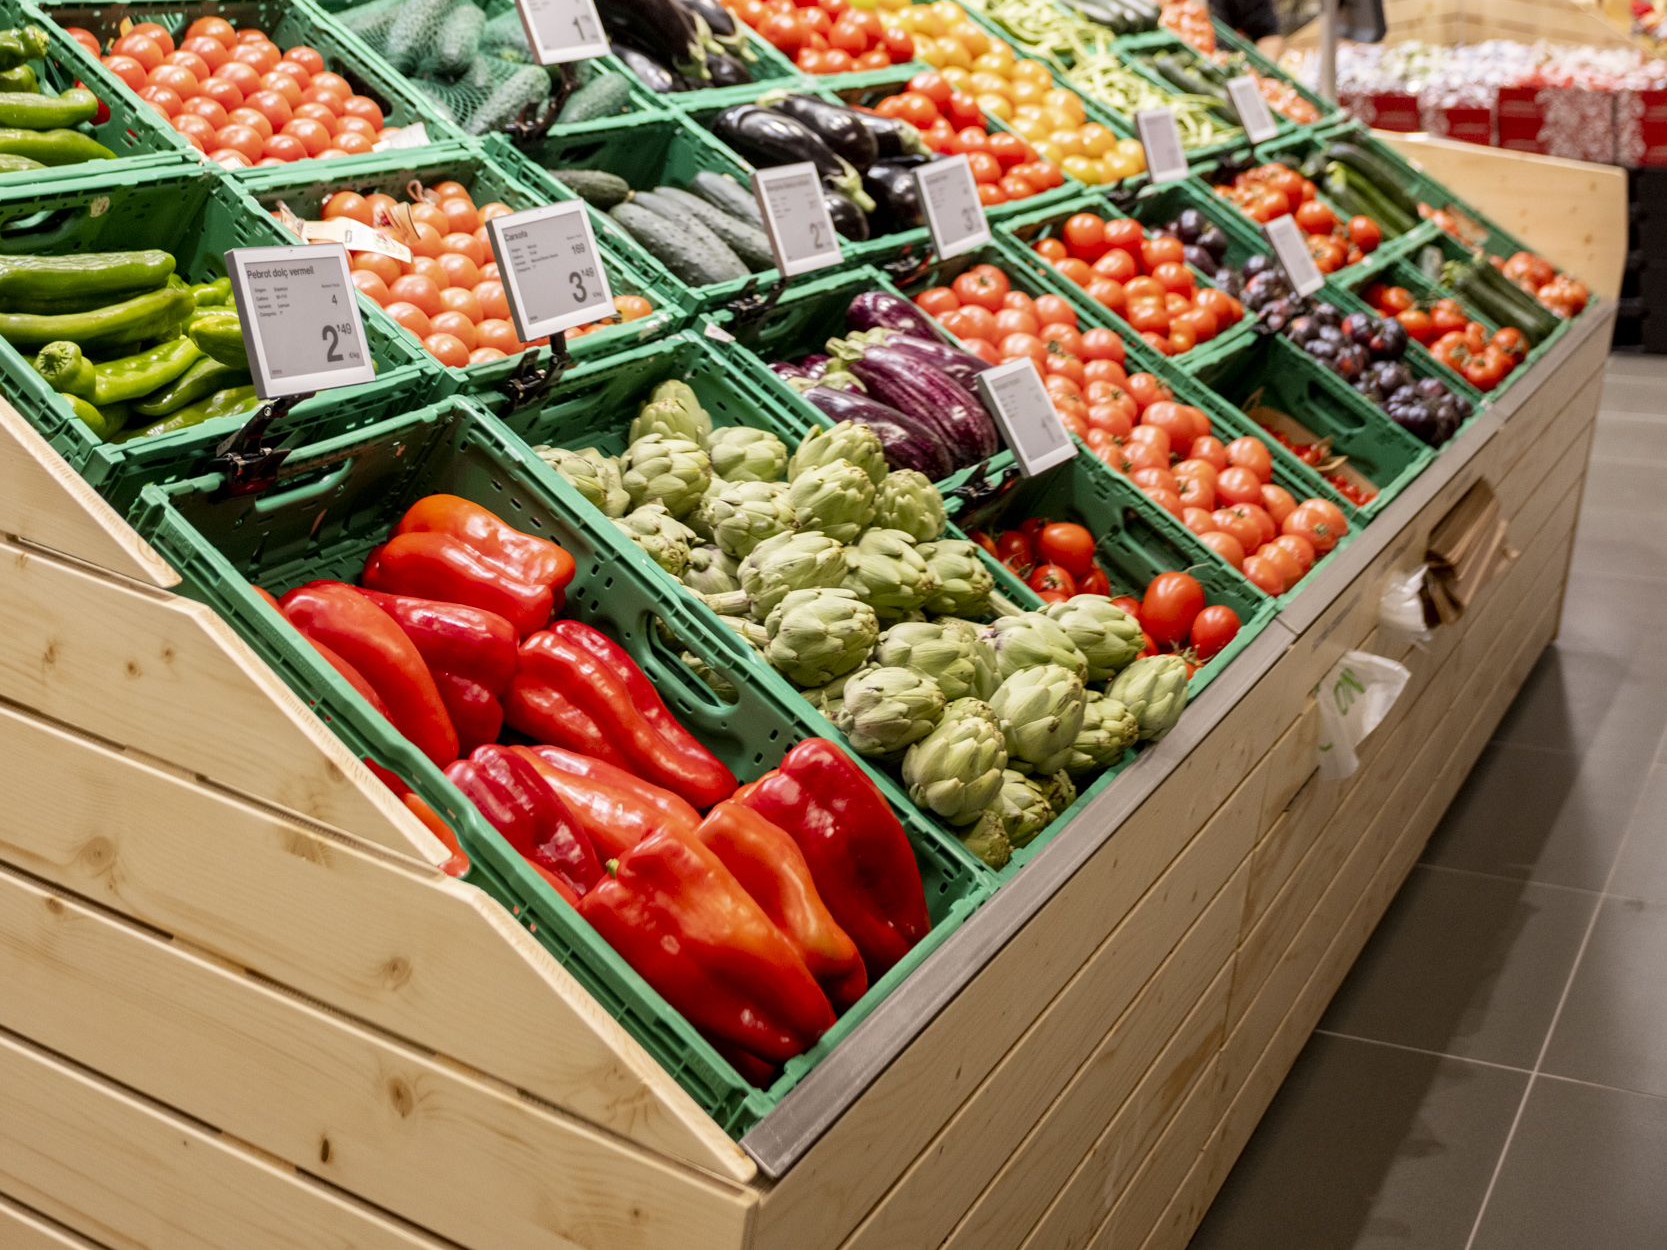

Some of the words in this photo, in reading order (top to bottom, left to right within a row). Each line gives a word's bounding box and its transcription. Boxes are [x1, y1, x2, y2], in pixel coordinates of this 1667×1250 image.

[504, 230, 528, 242] Carxofa
[247, 269, 272, 280] Pebrot
[273, 267, 288, 279] dolç
[289, 265, 314, 276] vermell
[332, 294, 338, 306] 4
